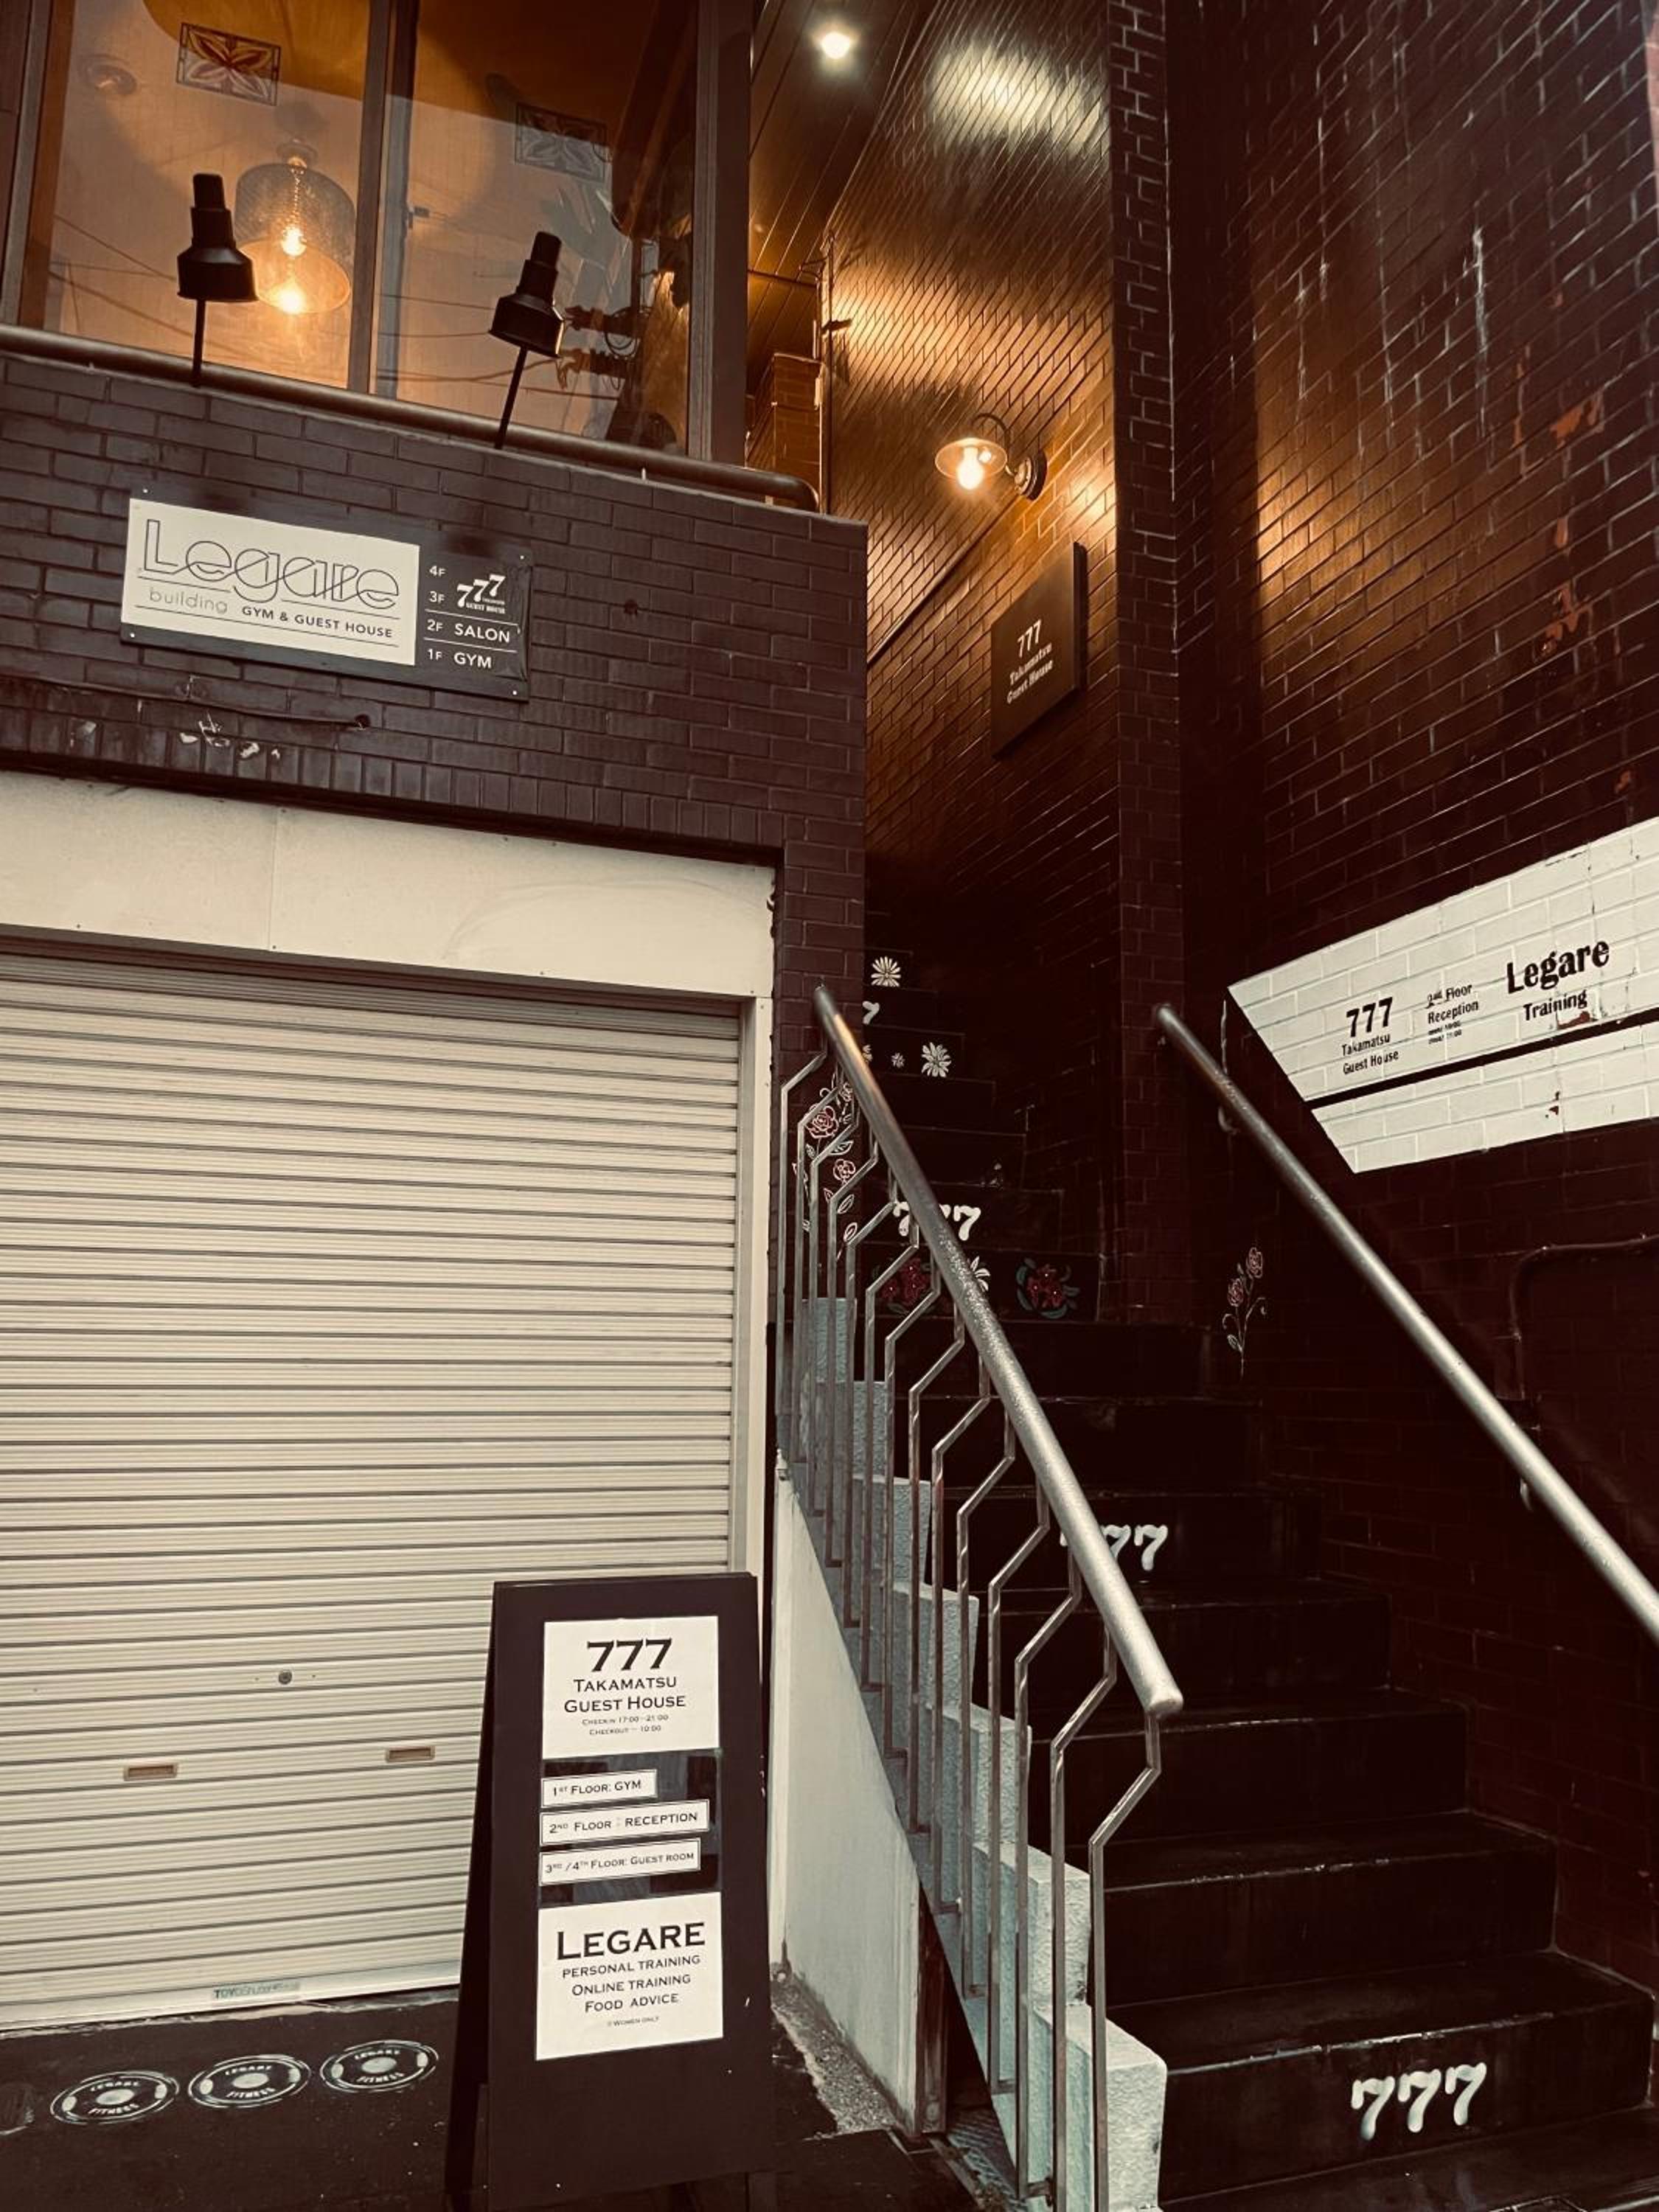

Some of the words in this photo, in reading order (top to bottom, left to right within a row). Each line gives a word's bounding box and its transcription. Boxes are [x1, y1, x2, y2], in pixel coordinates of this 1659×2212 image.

[144, 518, 400, 609] Legare
[429, 565, 446, 577] 4F
[150, 589, 229, 614] building
[429, 591, 445, 603] 3F
[457, 574, 507, 608] 777
[242, 605, 275, 621] GYM
[280, 611, 290, 622] &
[295, 613, 341, 633] GUEST
[345, 621, 393, 639] HOUSE
[427, 619, 443, 632] 2F
[454, 623, 509, 643] SALON
[1017, 619, 1041, 658] 777
[428, 648, 442, 661] 1F
[453, 652, 492, 669] GYM
[1506, 940, 1610, 994] Legare
[1427, 1001, 1478, 1024] Reception
[1523, 989, 1588, 1021] Training
[1346, 997, 1393, 1037] 777
[1342, 1034, 1391, 1057] Takamatsu
[1343, 1059, 1368, 1075] Guest
[1371, 1051, 1399, 1067] House
[587, 1638, 672, 1672] 777
[574, 1677, 677, 1693] TAKAMATSU
[564, 1699, 622, 1713] GUEST
[627, 1696, 686, 1711] HOUSE
[614, 1779, 641, 1791] GYM
[574, 1820, 612, 1832] FLOOR
[625, 1812, 698, 1828] RECEPTION
[630, 1854, 664, 1865] GUEST
[666, 1853, 695, 1862] ROOM
[557, 1921, 706, 1961] LEGARE
[563, 1961, 635, 1978] PERSONAL
[639, 1955, 701, 1970] TRAINING
[572, 1981, 625, 1996] ONLINE
[628, 1974, 692, 1990] TRAINING
[585, 2000, 624, 2013] FOOD
[630, 1993, 679, 2007] ADVICE
[1351, 2062, 1487, 2141] 777
